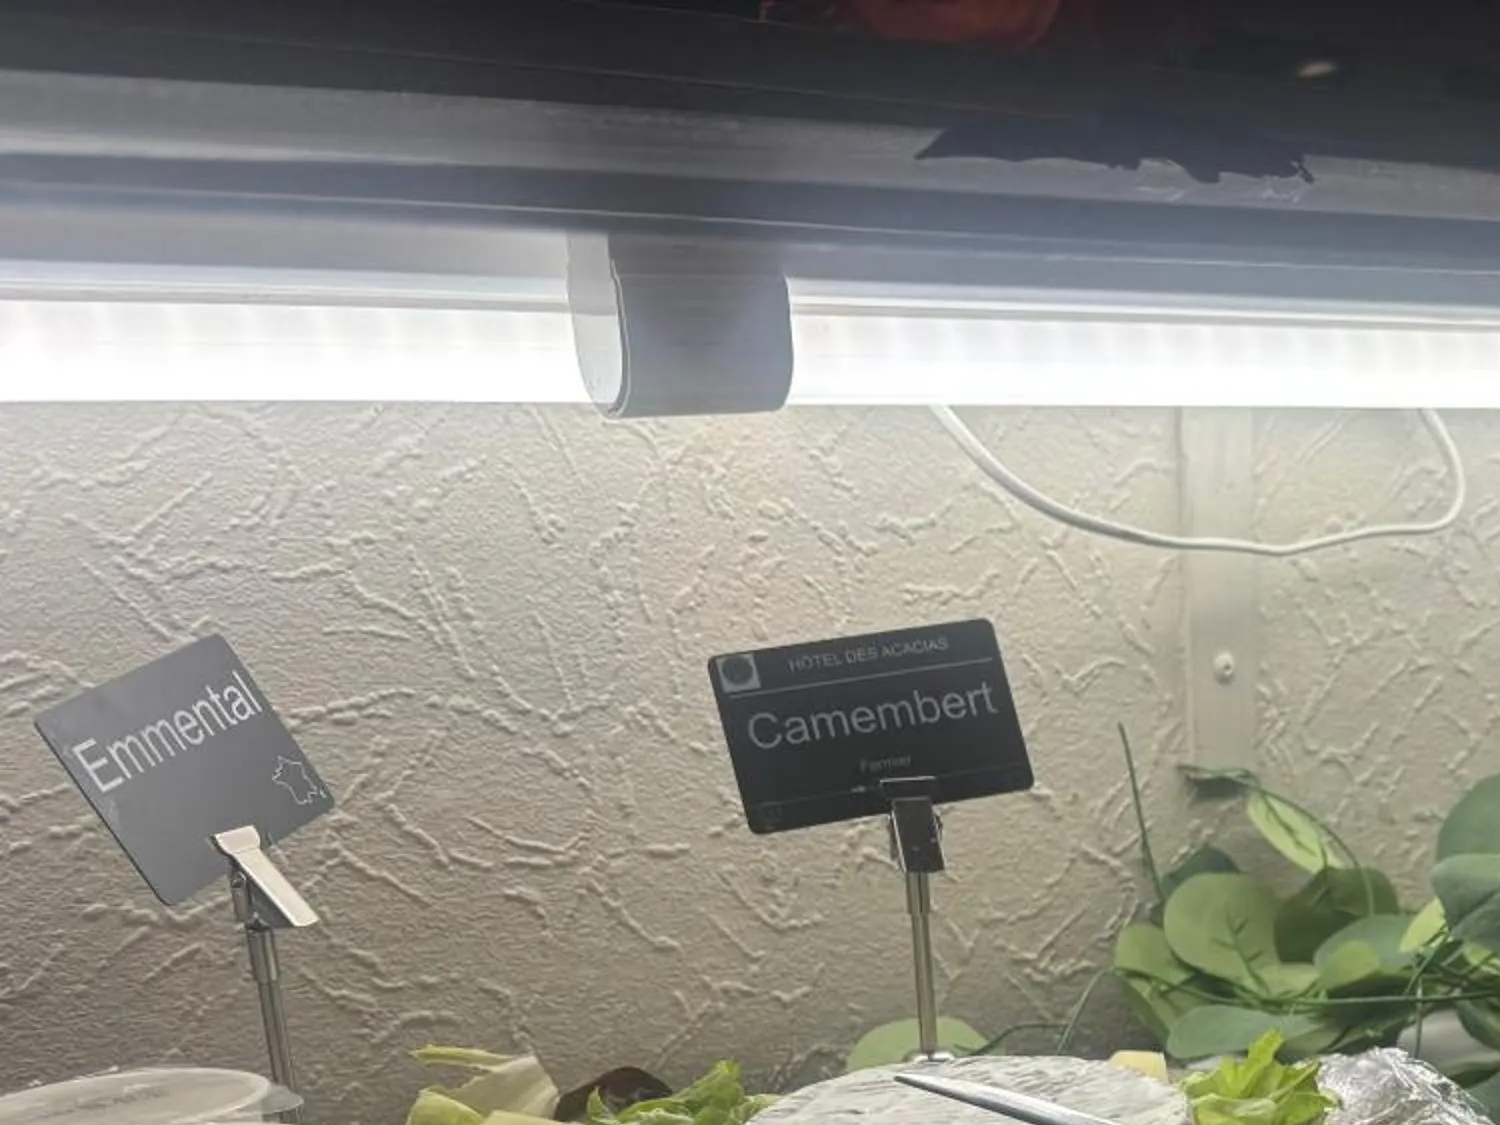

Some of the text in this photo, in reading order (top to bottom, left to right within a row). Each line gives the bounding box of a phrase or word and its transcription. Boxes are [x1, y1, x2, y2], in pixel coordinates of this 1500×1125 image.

[845, 647, 879, 664] DES
[880, 636, 949, 659] ACACIAS
[72, 668, 263, 793] Emmental
[747, 680, 999, 750] Camembert
